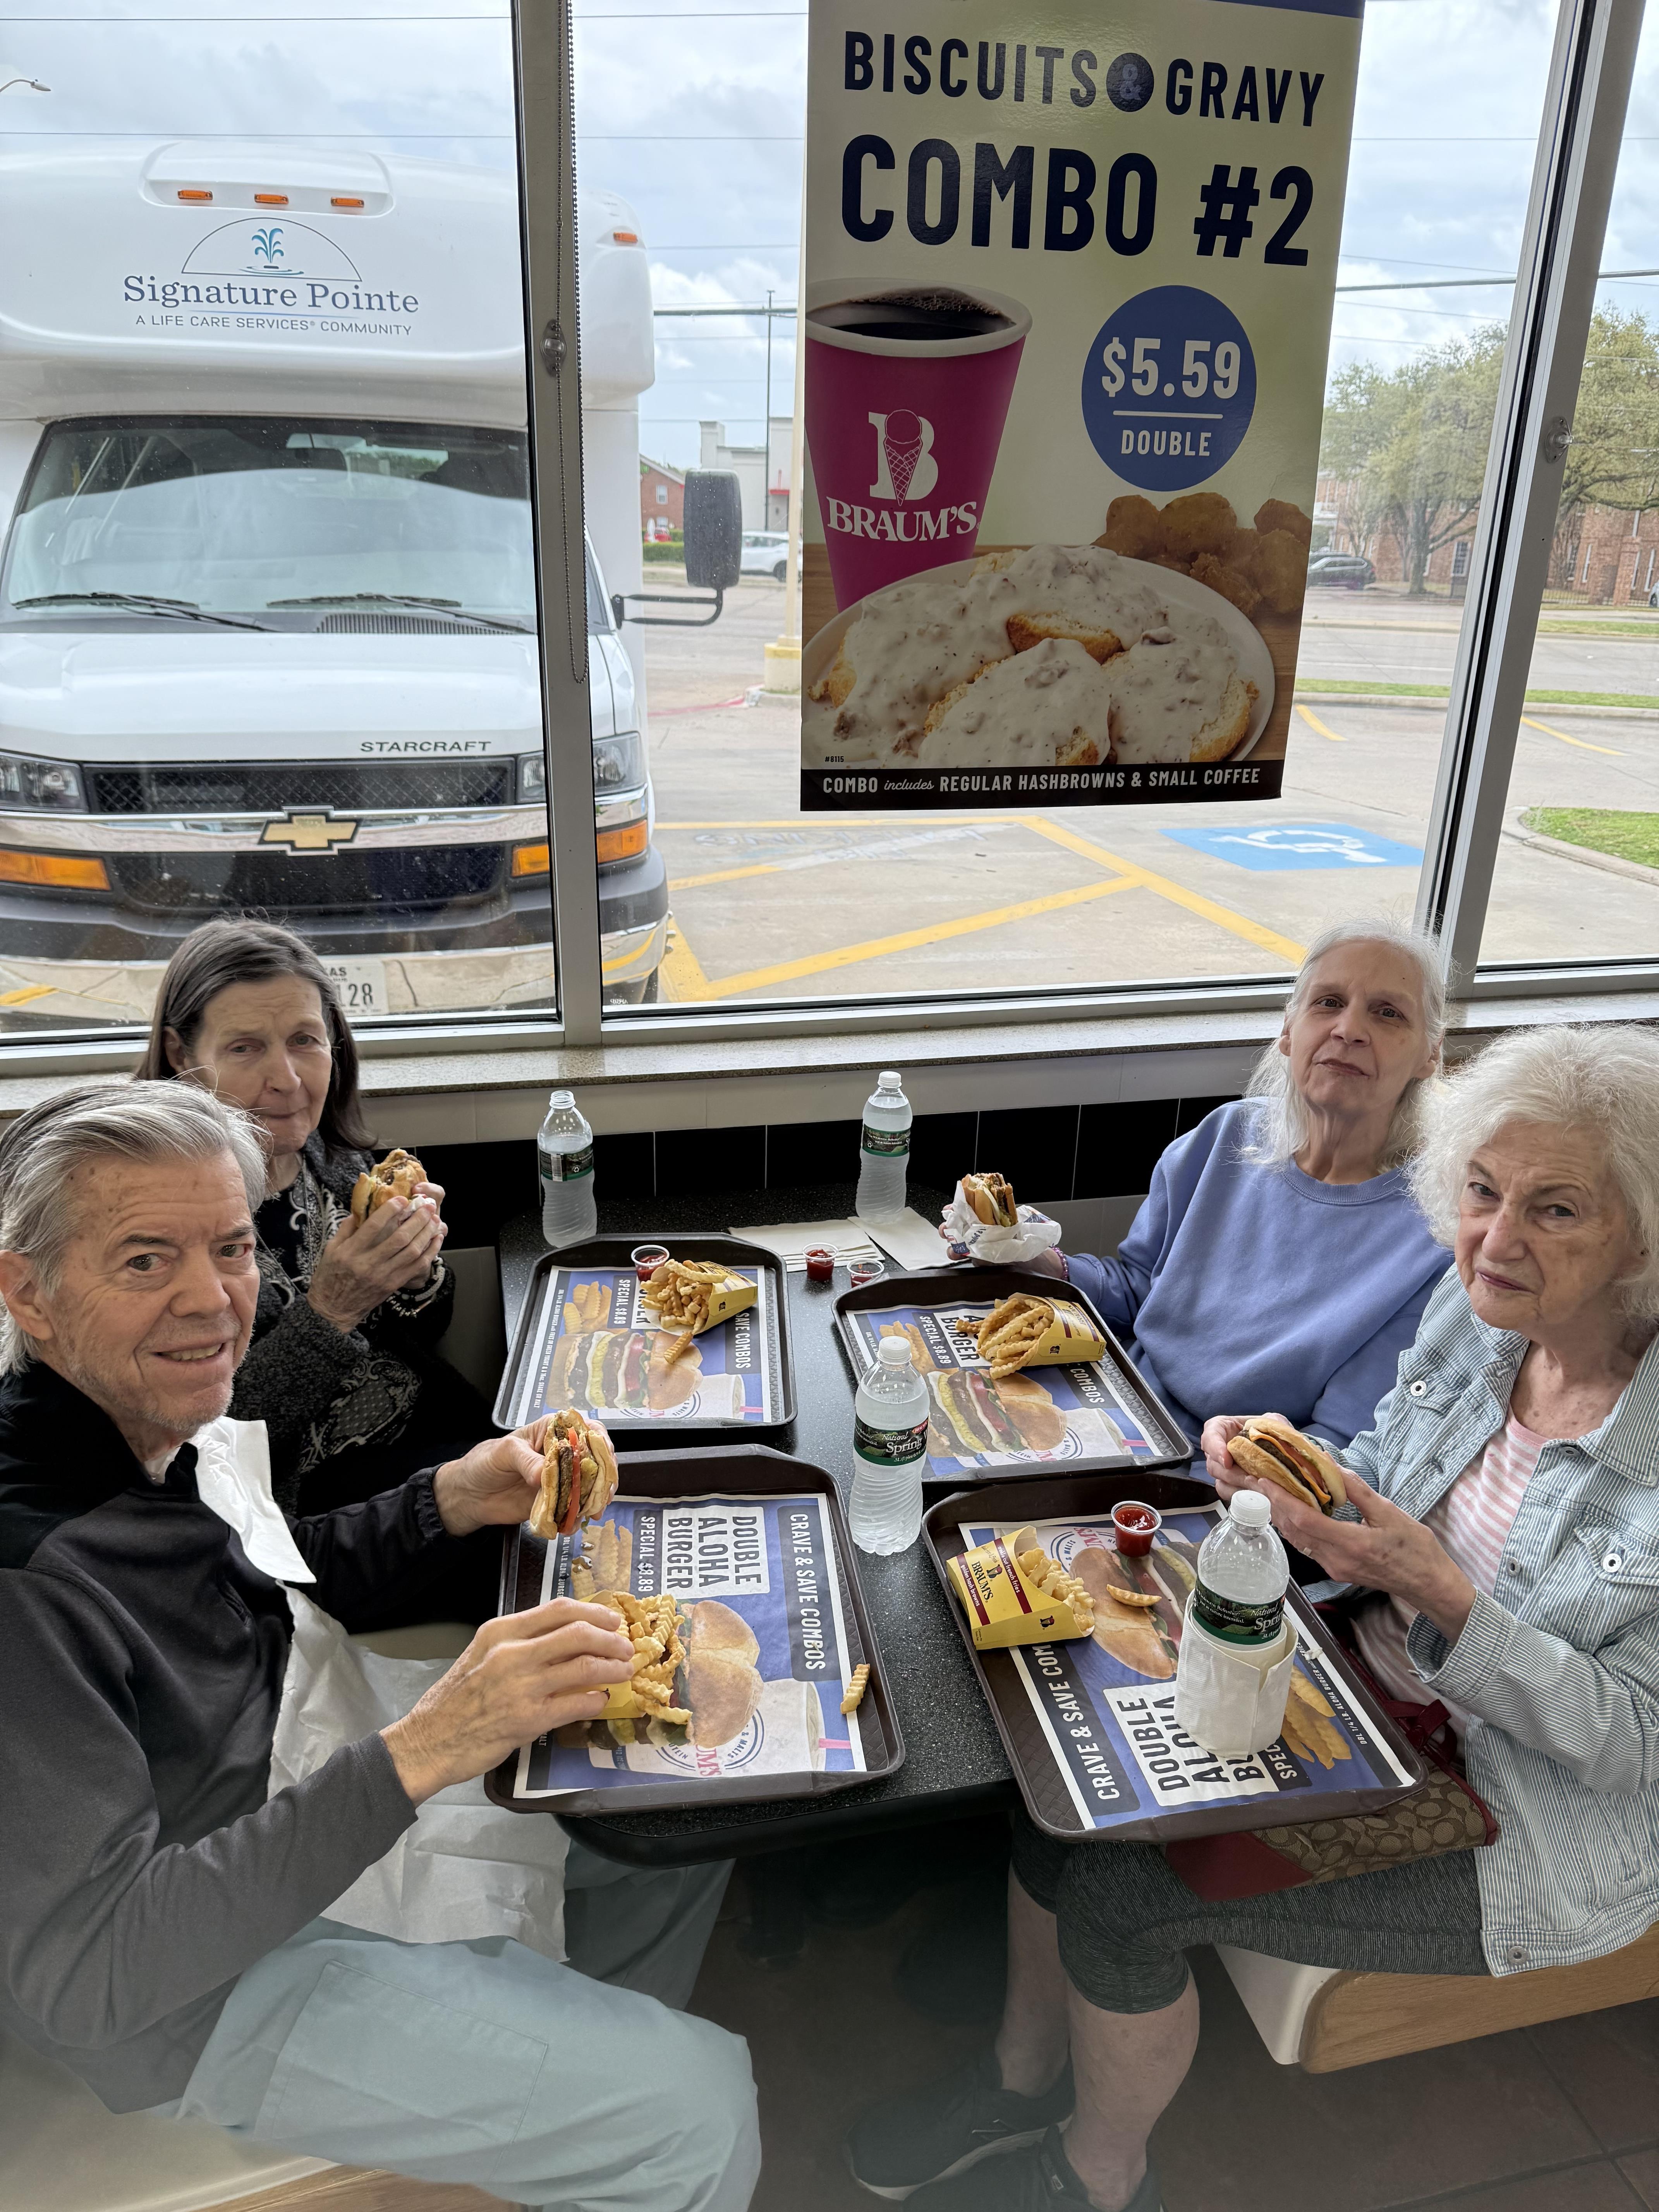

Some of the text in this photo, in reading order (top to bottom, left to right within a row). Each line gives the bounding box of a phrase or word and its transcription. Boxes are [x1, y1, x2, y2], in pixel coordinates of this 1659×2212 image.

[844, 31, 1097, 108] BISCUITS
[1166, 58, 1324, 127] GRAVY
[842, 134, 1314, 266] COMBO #2
[124, 276, 419, 313] Signature Pointe
[136, 315, 145, 325] A
[152, 316, 183, 326] LIFE
[191, 316, 230, 328] CARE
[321, 321, 412, 336] COMMUNITY
[1102, 337, 1240, 399] $5.59
[1122, 429, 1211, 457] DOUBLE
[826, 496, 977, 542] BRAUM'S
[361, 741, 492, 752] STARCRAFT
[823, 768, 1261, 793] COMBO includes REGULAR HASHBROWNS & SMALL COFFEE
[614, 1279, 630, 1324] SPECIAL $8.89
[735, 1313, 751, 1369] SAVE COMBOS
[920, 1316, 951, 1364] SPECIAL $8.89
[1070, 1369, 1105, 1403] COMBOS
[882, 1432, 908, 1440] Natural
[886, 1437, 922, 1456] Spring
[639, 1516, 655, 1559] SPECIAL
[667, 1517, 693, 1589] BURGER
[698, 1517, 729, 1587] ALOHA
[732, 1516, 761, 1584] DOUBLE
[790, 1514, 826, 1669] CRAVE & SAVE COMBOS
[960, 1565, 969, 1578] golden
[970, 1588, 980, 1606] browns
[972, 1561, 993, 1599] BRAUM'S
[1006, 1565, 1016, 1580] french
[1012, 1580, 1020, 1593] fries
[1250, 1603, 1278, 1616] Natural
[1313, 1669, 1331, 1690] BURGER
[1328, 1692, 1344, 1709] ALOHA
[1342, 1711, 1351, 1720] LB.
[1032, 1645, 1120, 1800] CRAVE & SAVE COM
[1348, 1722, 1358, 1731] 1/4
[1356, 1733, 1368, 1744] DBL
[728, 1739, 748, 1759] MALTS
[1116, 1698, 1190, 1791] DOUBLE
